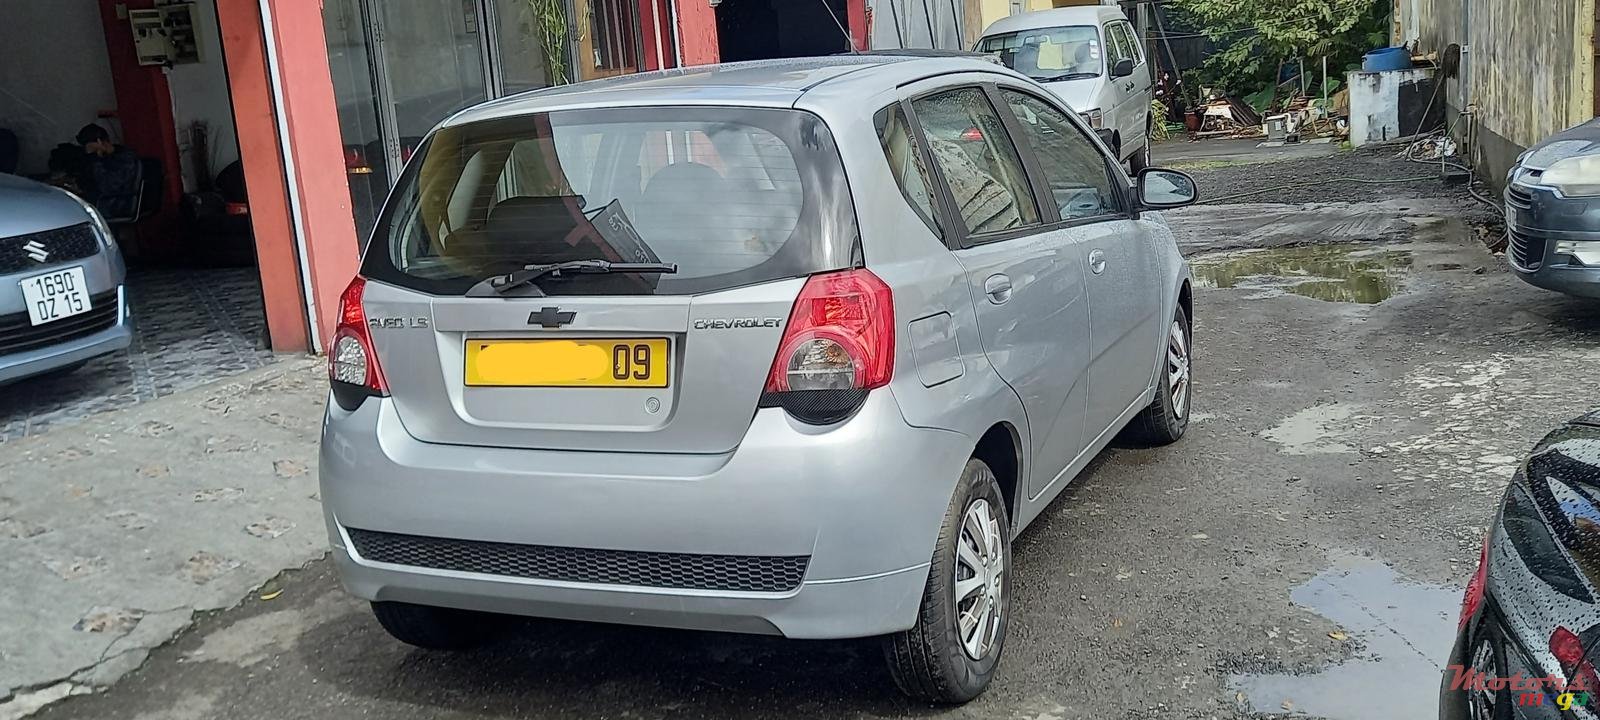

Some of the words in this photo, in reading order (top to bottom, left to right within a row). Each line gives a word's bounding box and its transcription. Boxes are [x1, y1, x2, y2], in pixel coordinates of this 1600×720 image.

[36, 272, 74, 298] 1690
[64, 292, 83, 313] 15
[409, 316, 428, 329] LS
[694, 317, 783, 329] CHEVROLET
[613, 344, 651, 380] 09
